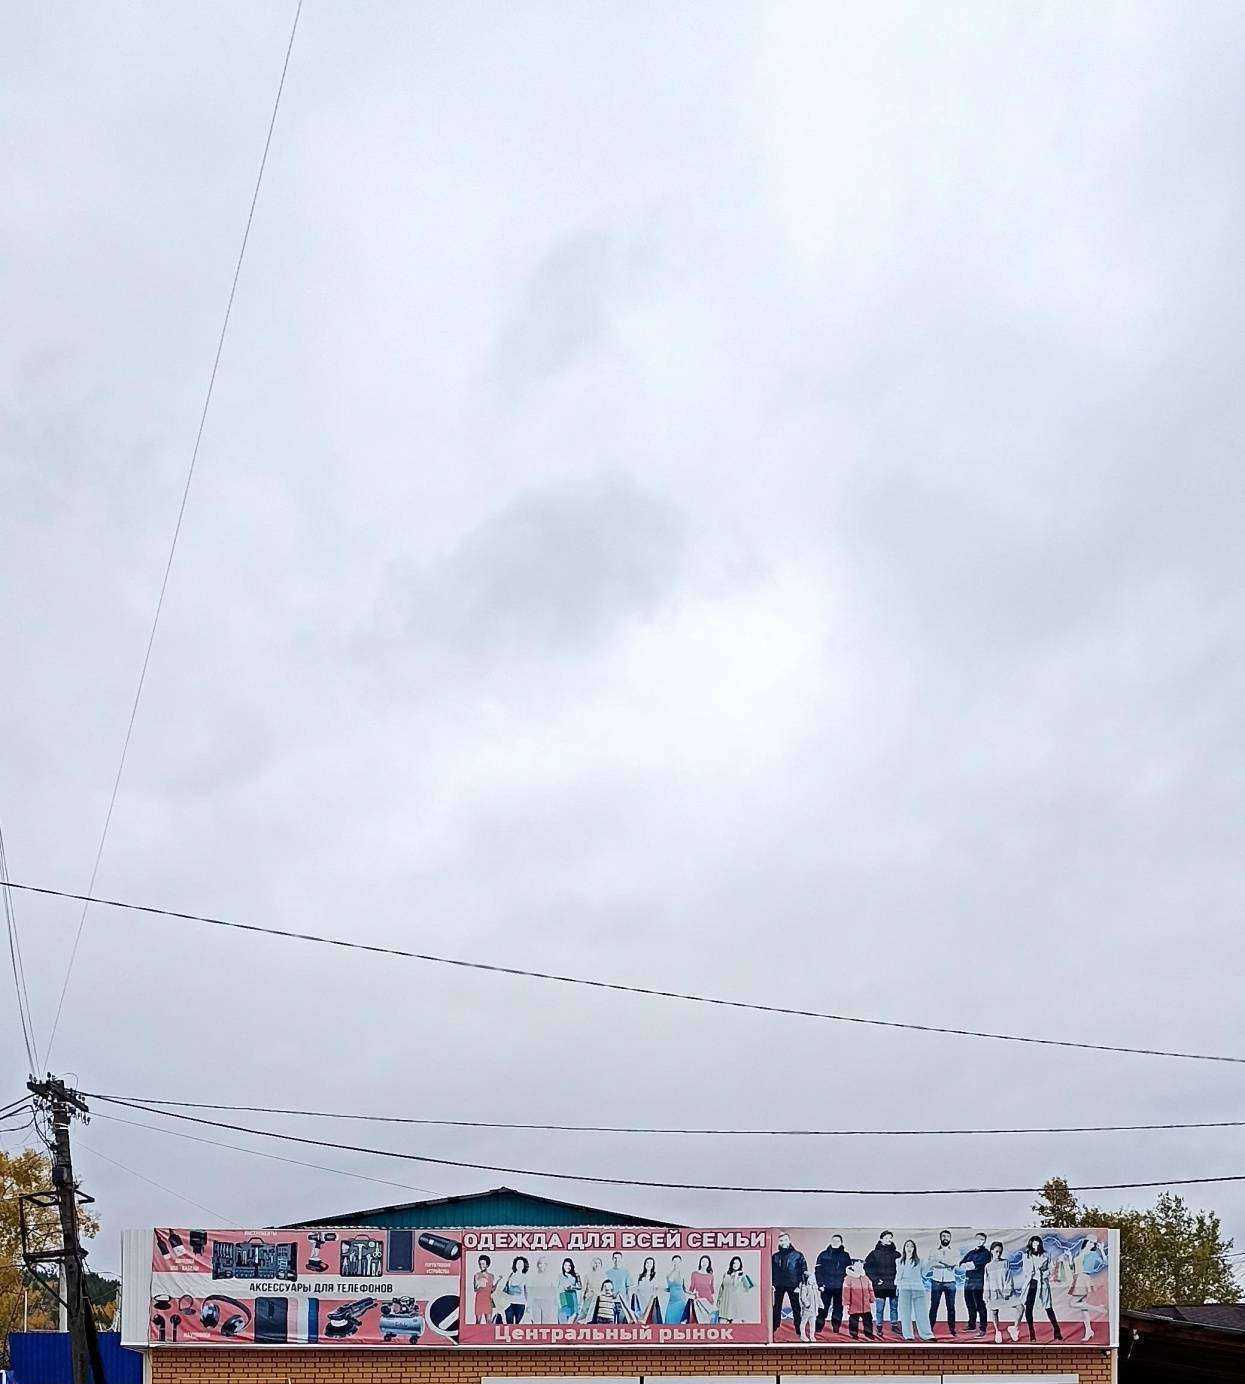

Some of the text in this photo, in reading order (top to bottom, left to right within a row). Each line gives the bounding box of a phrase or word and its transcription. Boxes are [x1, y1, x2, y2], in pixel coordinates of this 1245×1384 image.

[463, 1229, 766, 1251] ОДЕЖДА ДЛЯ ВСЕЙ СЕМЬИ
[249, 1283, 393, 1293] АКСЕССУАРЫ ДЛЯ ТЕЛЕФОНОВ
[495, 1325, 734, 1343] Центральный рынок
